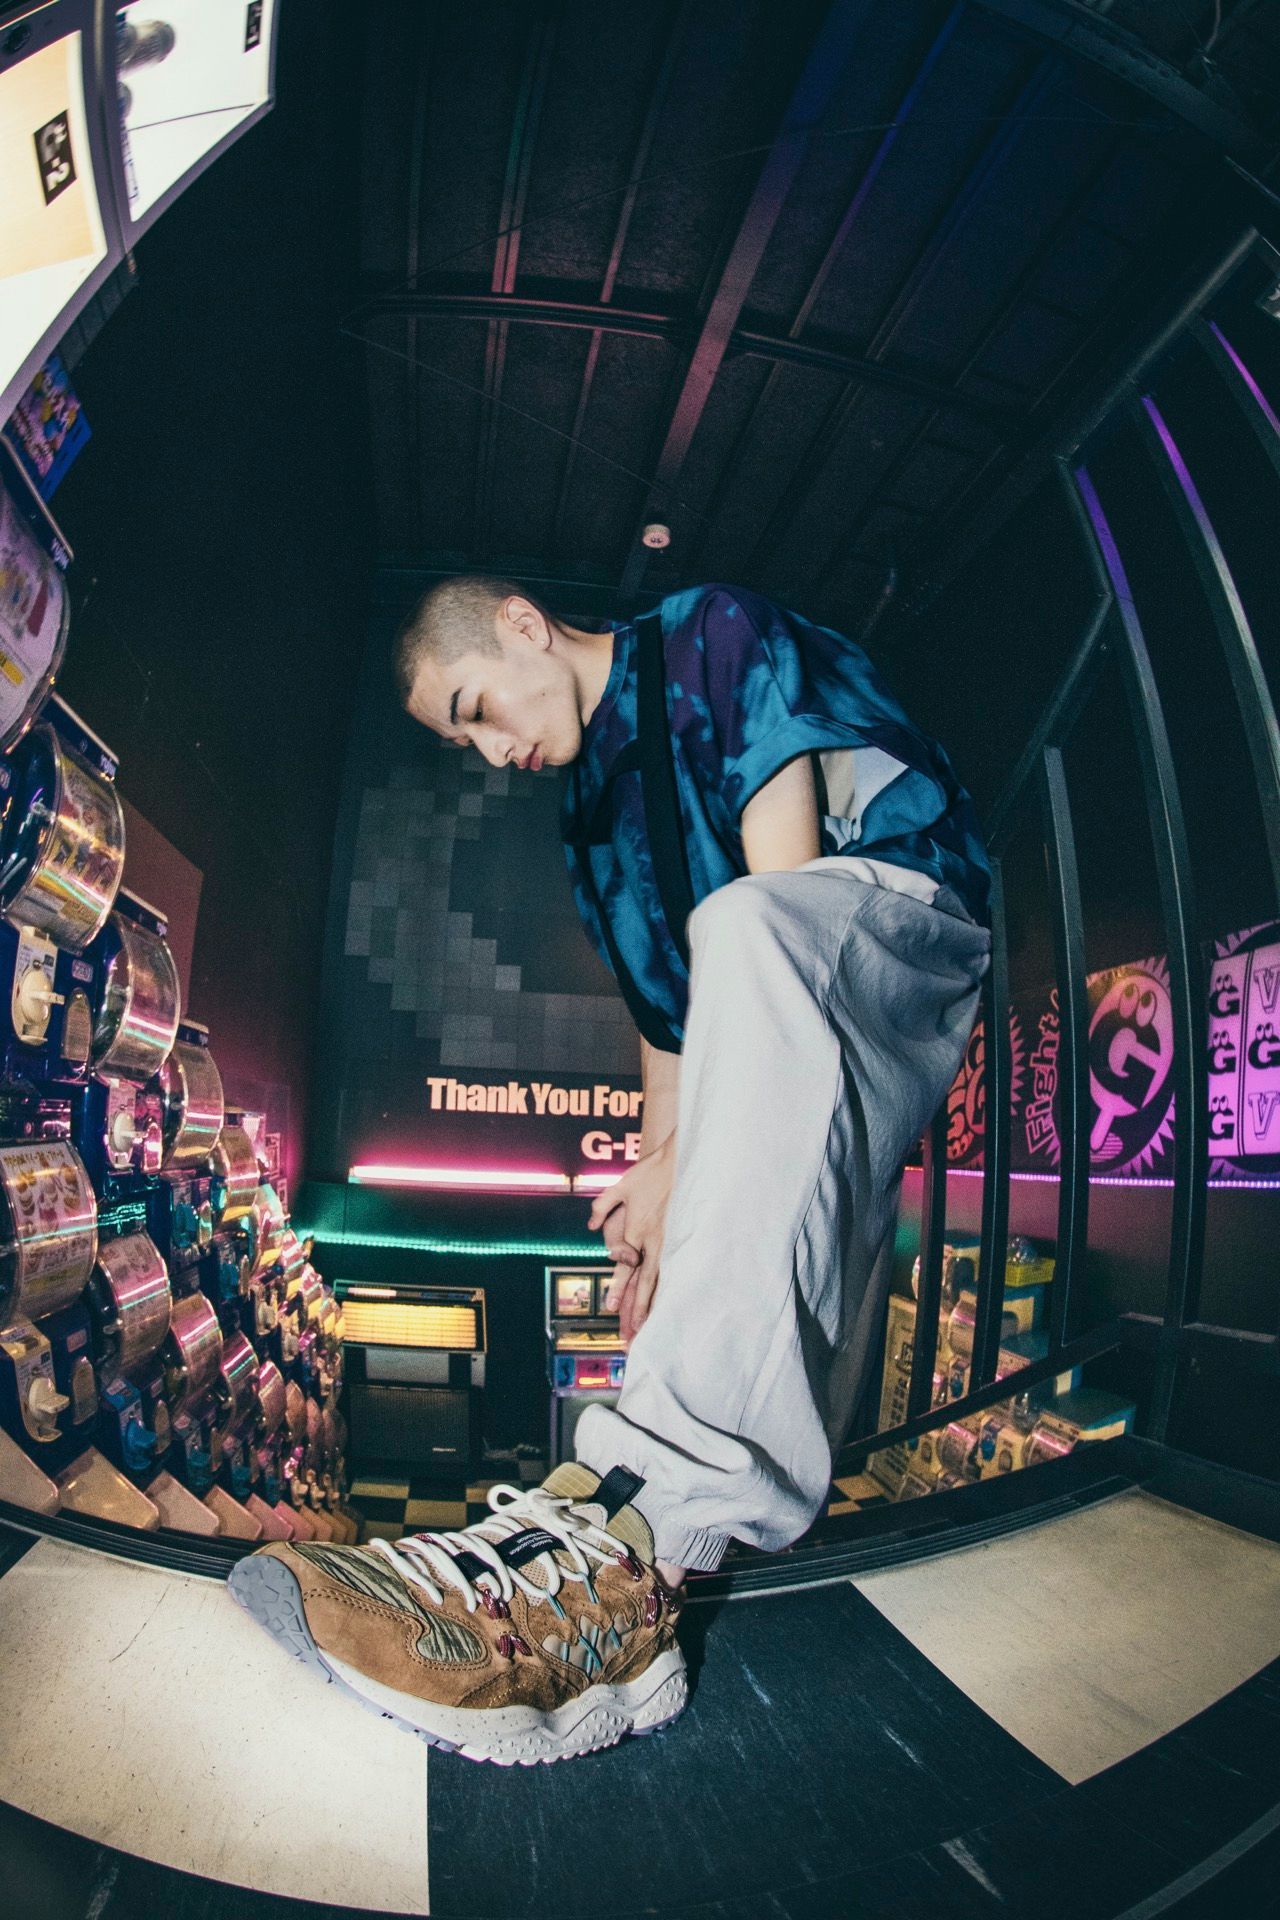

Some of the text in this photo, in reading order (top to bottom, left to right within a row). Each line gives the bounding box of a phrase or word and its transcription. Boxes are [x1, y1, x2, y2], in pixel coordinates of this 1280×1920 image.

[426, 1076, 643, 1118] Thank You For
[1025, 1011, 1061, 1154] Fight
[1248, 1091, 1280, 1141] V
